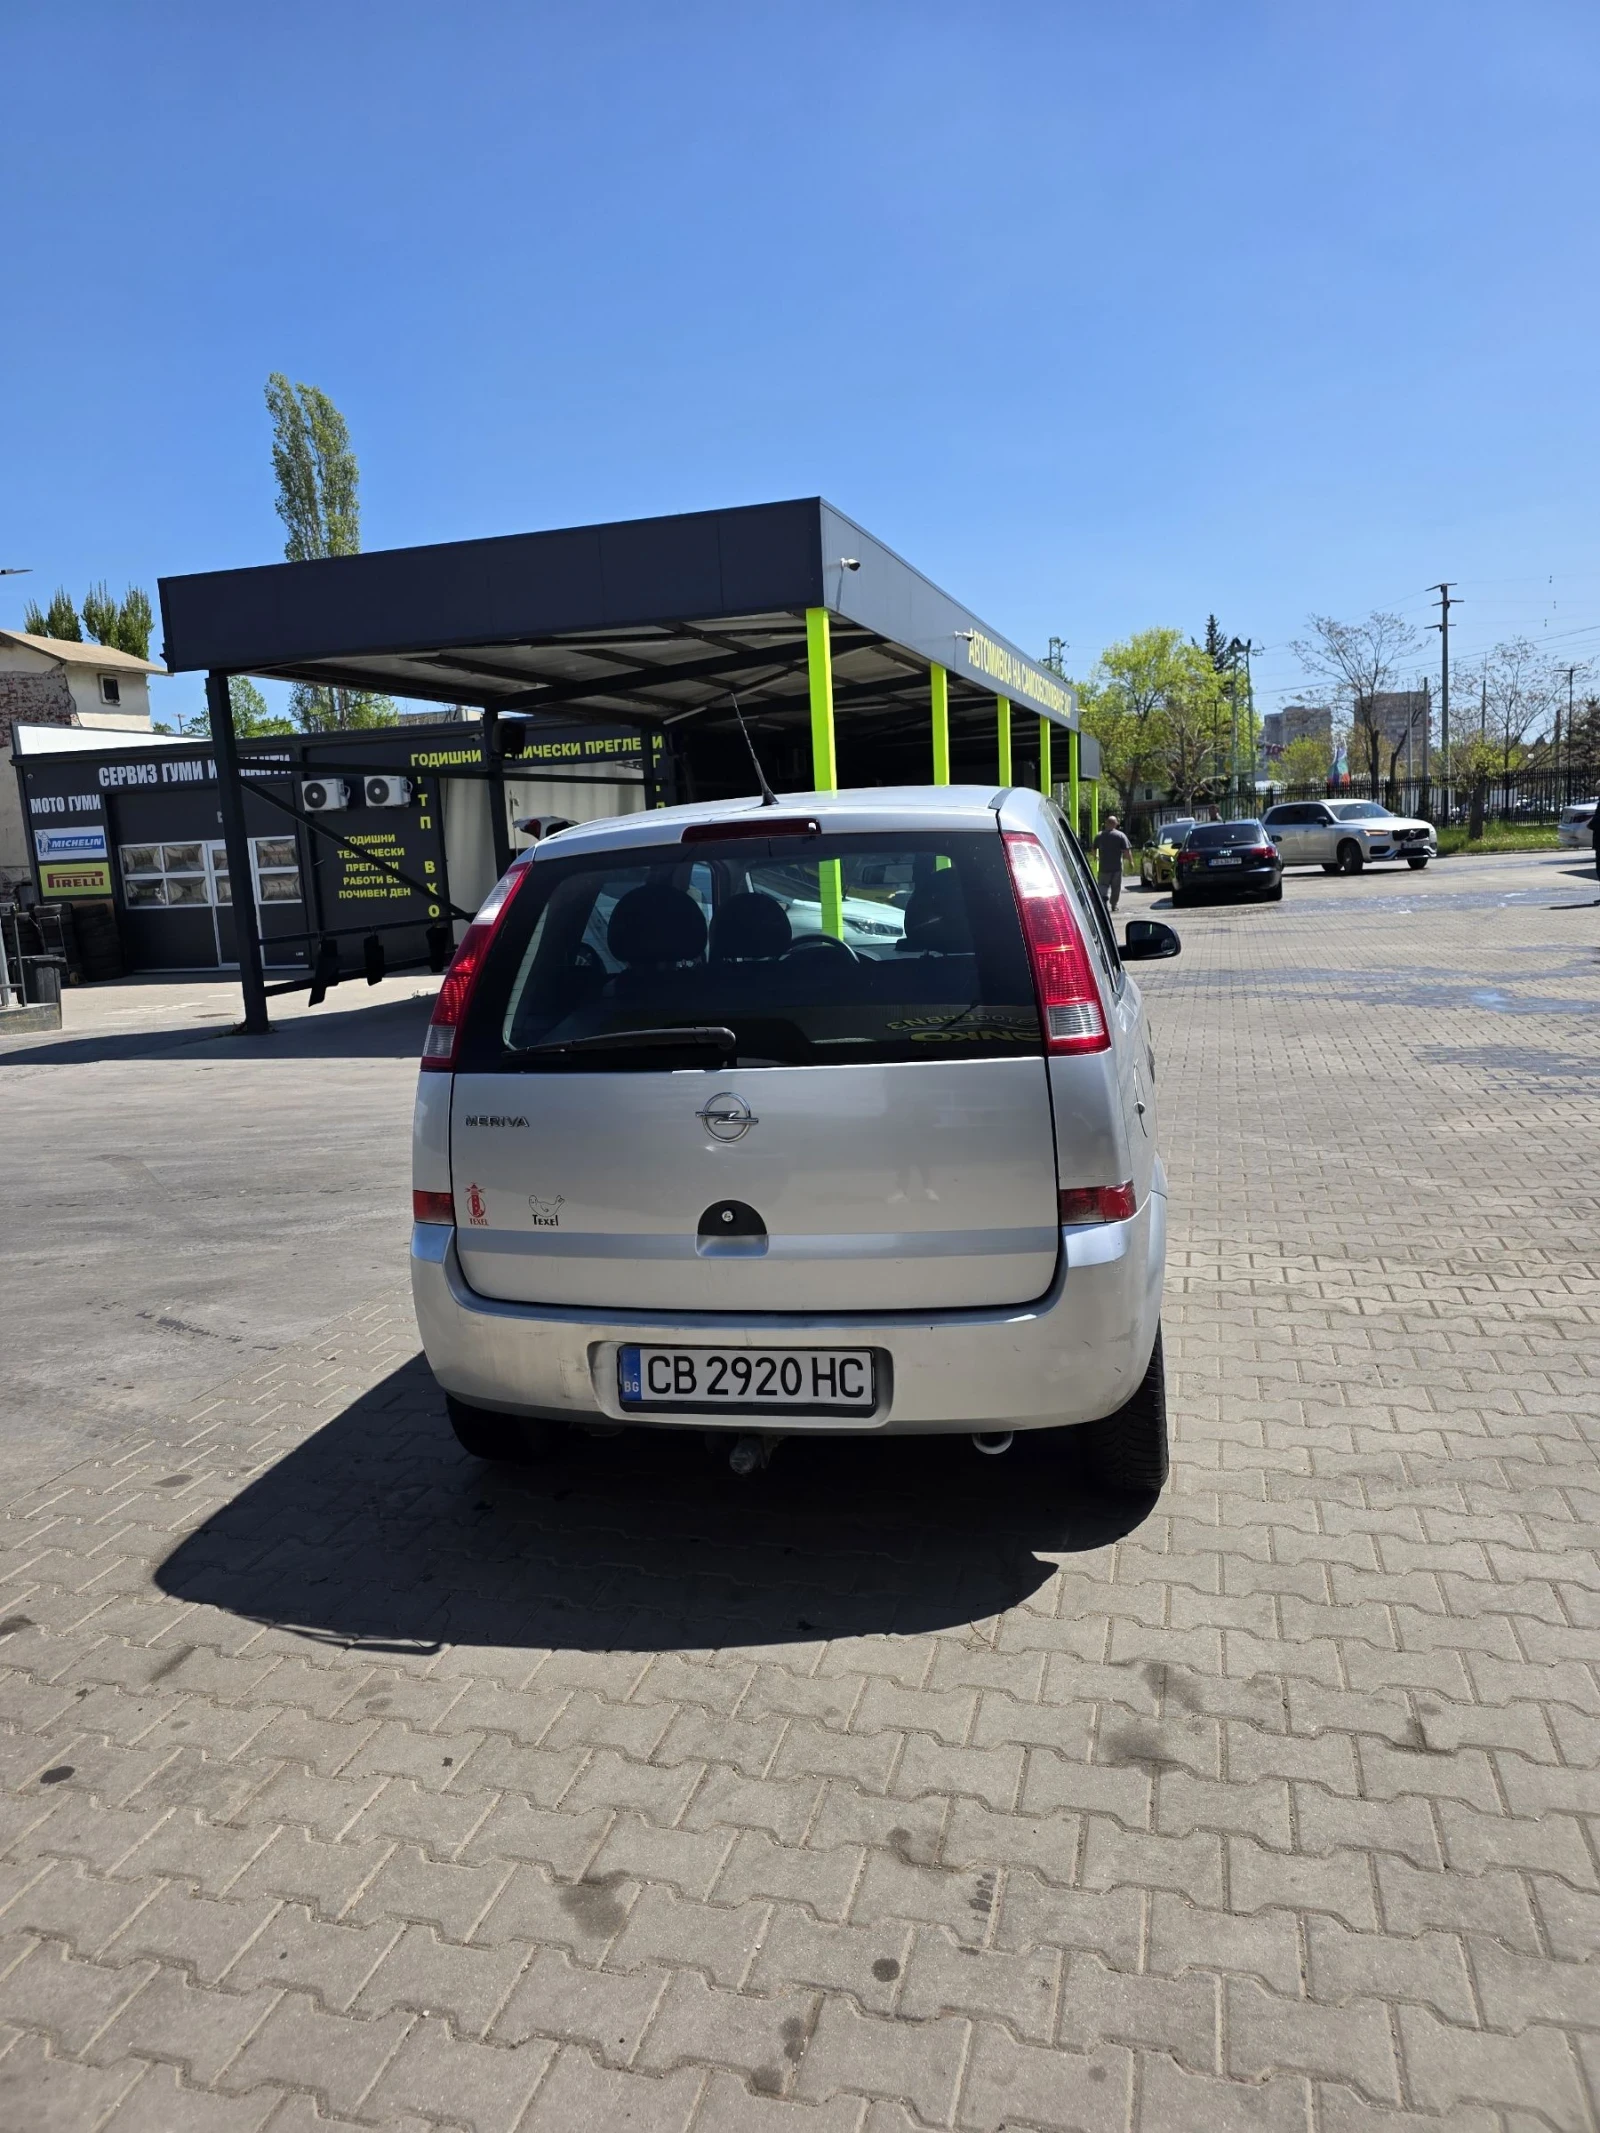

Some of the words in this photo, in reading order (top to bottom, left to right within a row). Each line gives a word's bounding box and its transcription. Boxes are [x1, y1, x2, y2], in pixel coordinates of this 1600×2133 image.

[411, 749, 482, 767] ГОДИШНИ
[98, 763, 158, 787] СЕРВИЗ
[161, 760, 203, 783] ГУМИ
[30, 797, 65, 814] МОТО
[68, 794, 102, 812] ГУМИ
[51, 838, 102, 848] MICHELIN
[344, 834, 396, 845] ОДИШНИ
[47, 871, 104, 888] PIRELLI
[343, 875, 384, 886] РАБОТИ
[339, 889, 387, 899] ПОЧИВЕН
[390, 888, 411, 899] ДЕН
[465, 1115, 530, 1128] MERIVA
[469, 1218, 489, 1226] TEXEL
[647, 1355, 698, 1395] CB
[706, 1355, 803, 1397] 2920
[811, 1356, 865, 1399] HC
[623, 1380, 640, 1393] BG
